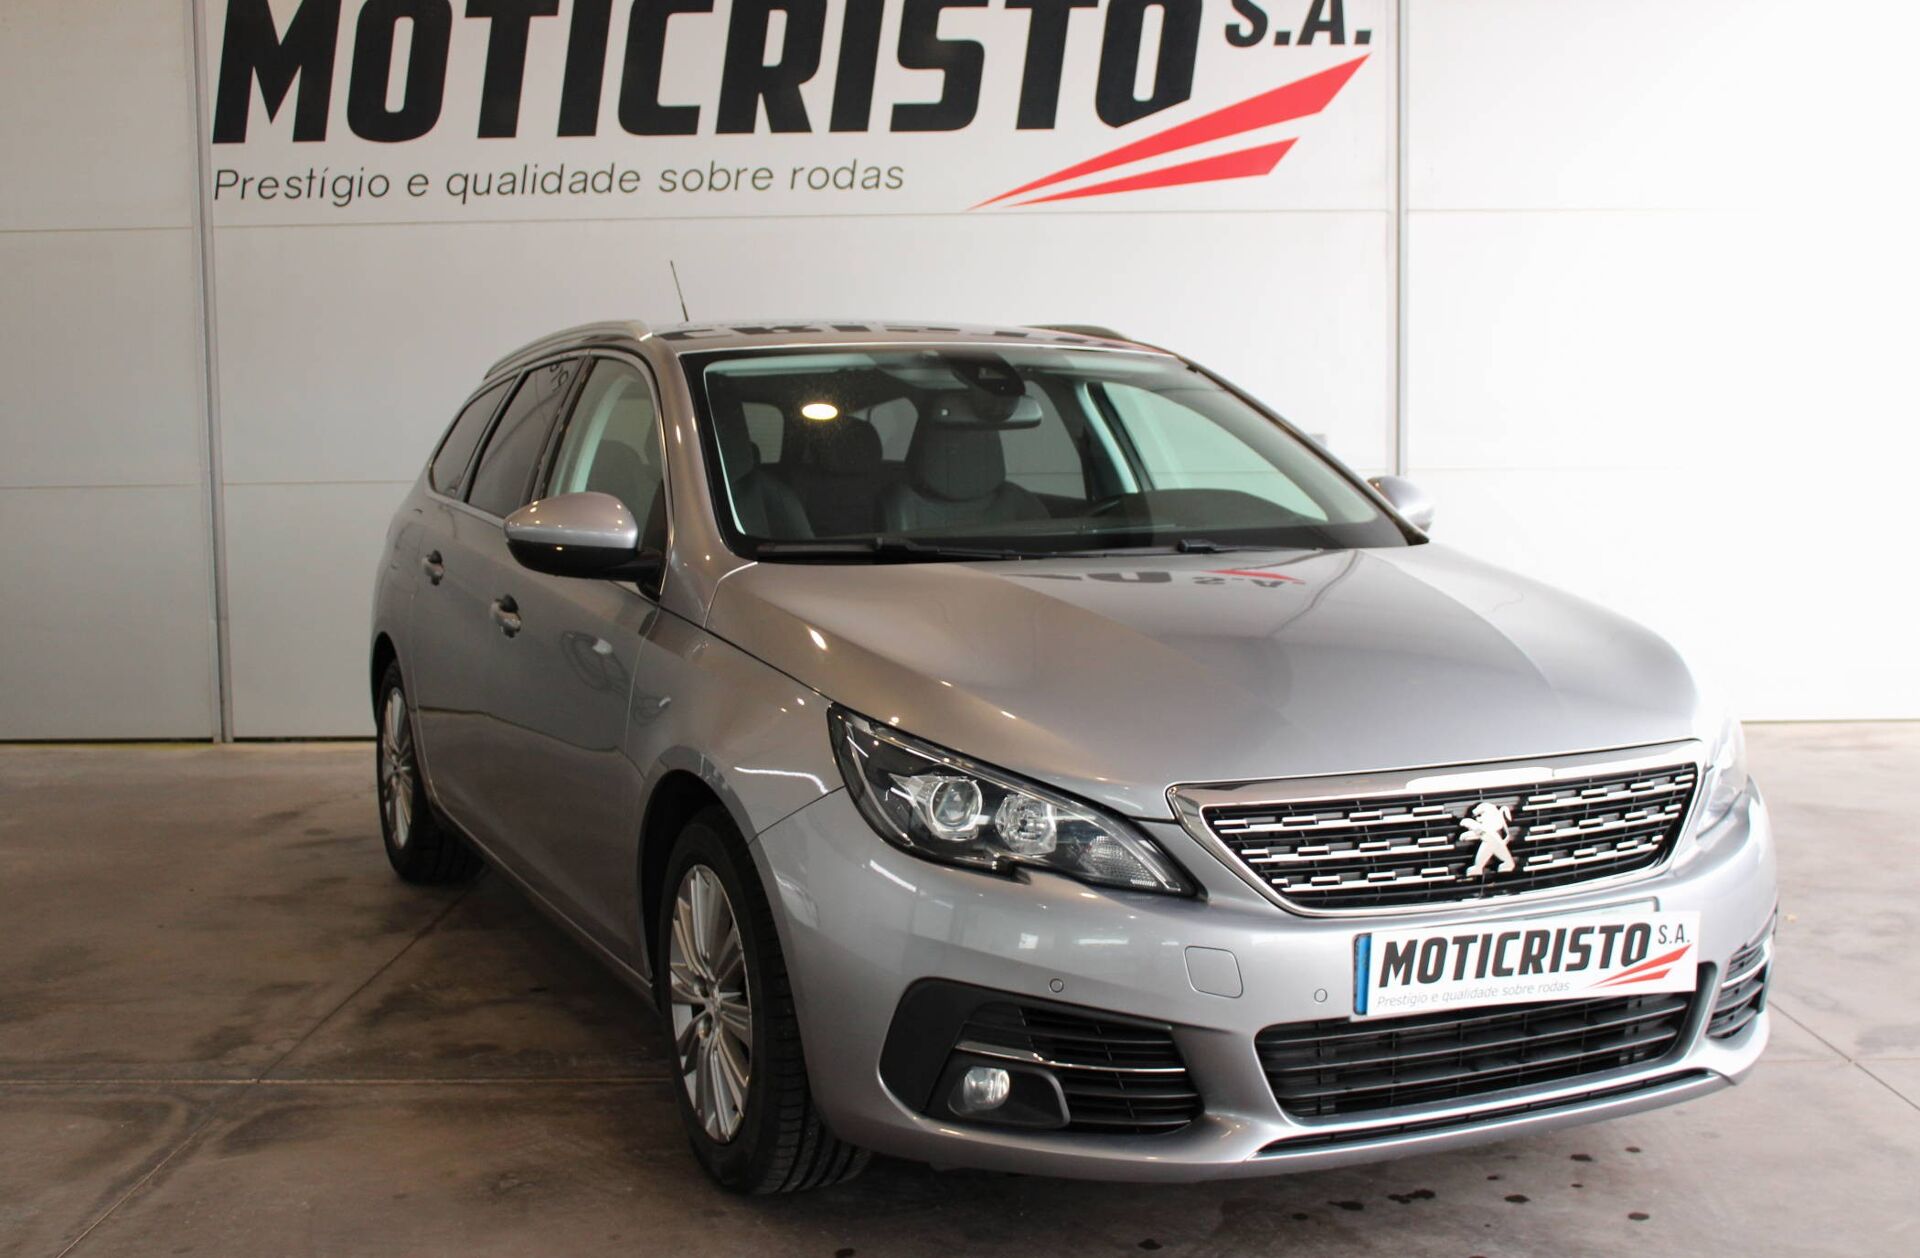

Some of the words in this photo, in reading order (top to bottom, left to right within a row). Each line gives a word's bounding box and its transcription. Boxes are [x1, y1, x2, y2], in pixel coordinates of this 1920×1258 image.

[212, 0, 1202, 143] MOTICRISTO
[1225, 0, 1371, 48] S.A.
[213, 166, 390, 208] Prestígio
[406, 173, 430, 198] e
[446, 162, 641, 206] qualidade
[658, 160, 774, 193] sobre
[790, 158, 904, 190] rodas
[1379, 922, 1652, 988] MOTICRISTO
[1657, 923, 1691, 945] S.A.
[1431, 993, 1439, 1003] e
[1441, 986, 1499, 1003] qualidade
[1502, 983, 1534, 996] sobre
[1537, 979, 1570, 993] rodas
